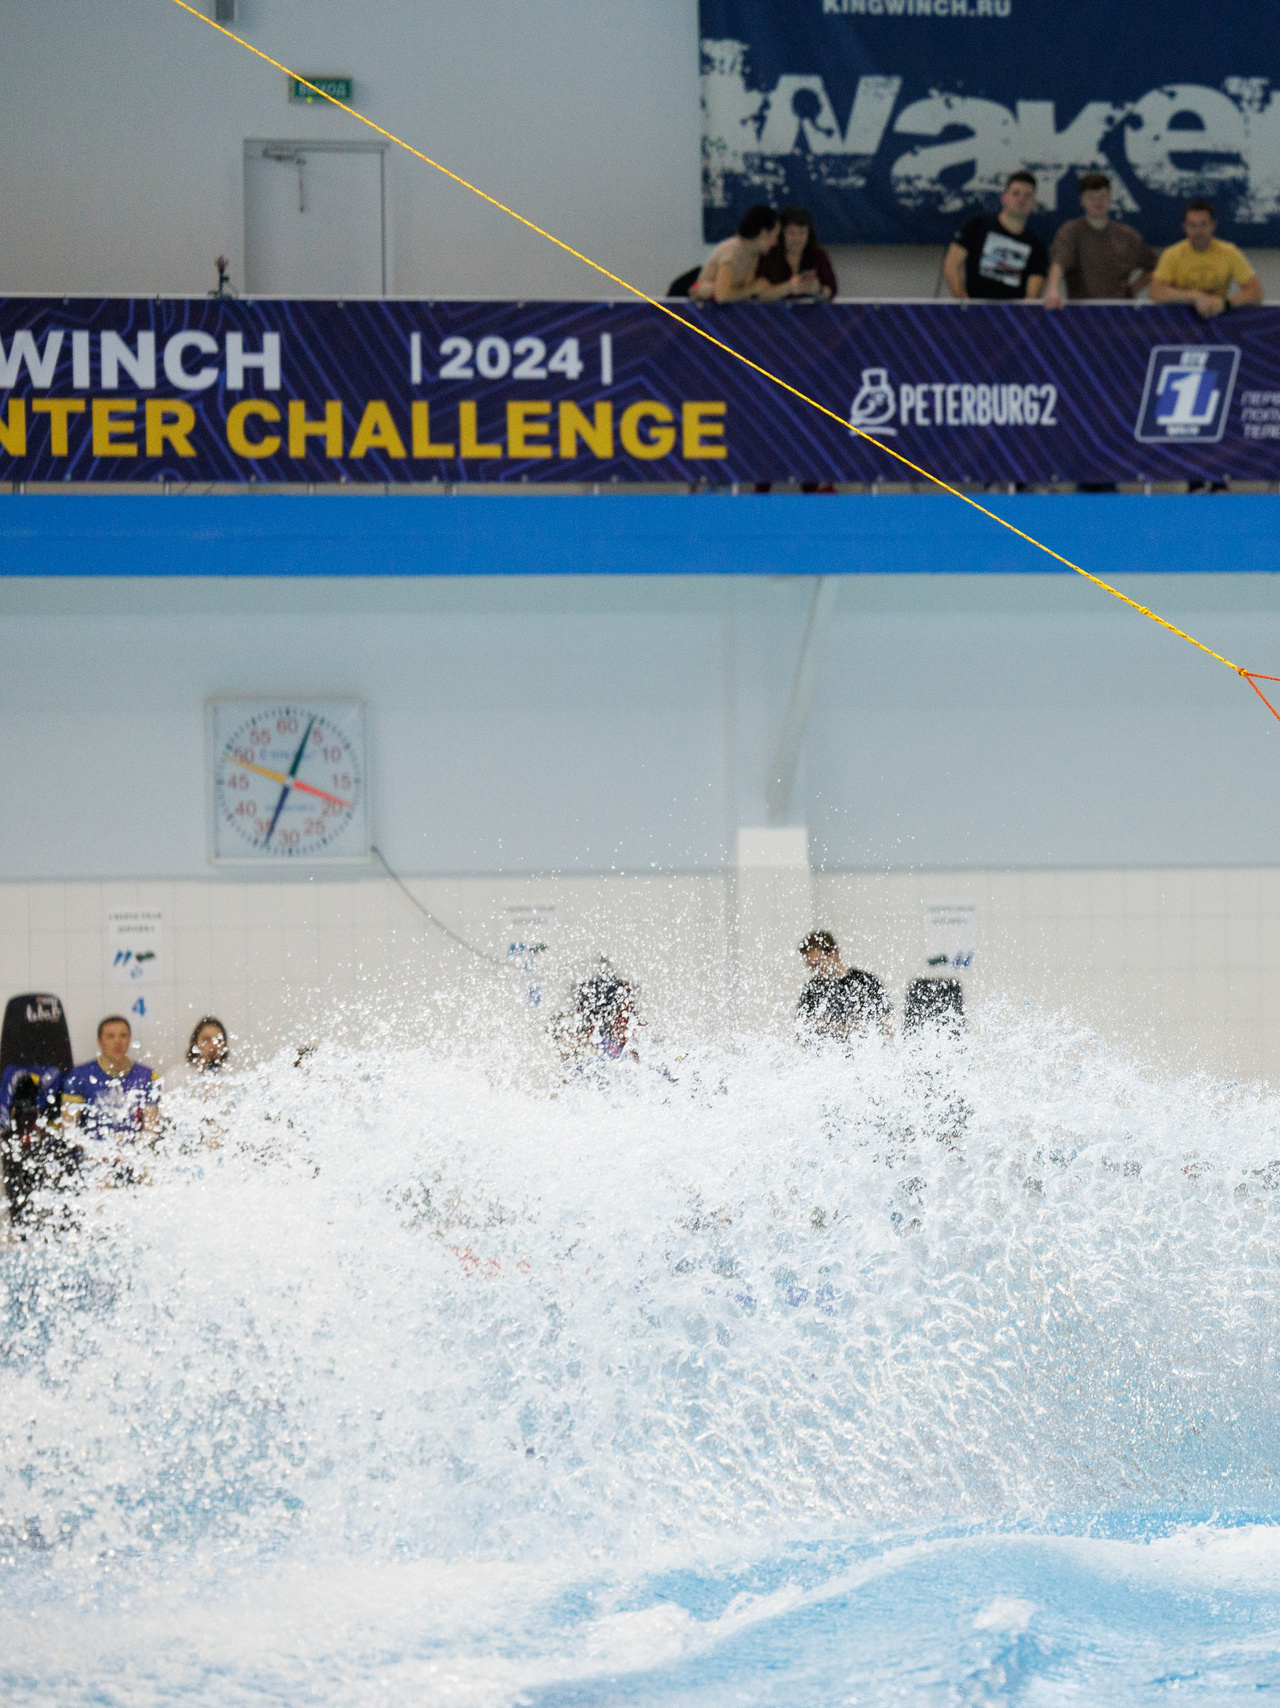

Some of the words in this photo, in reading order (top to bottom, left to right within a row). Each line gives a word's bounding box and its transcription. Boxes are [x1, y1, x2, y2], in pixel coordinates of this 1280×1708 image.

[0, 329, 281, 390] WINCH
[900, 383, 1058, 427] PETERBURG2
[226, 400, 728, 460] CHALLENGE
[276, 718, 299, 735] 60
[251, 728, 271, 746] 55
[312, 728, 324, 745] 5
[322, 746, 342, 763] 10
[227, 774, 249, 791] 45
[333, 773, 351, 790] 15
[235, 801, 257, 817] 40
[304, 818, 326, 835] 25
[279, 829, 300, 846] 30
[132, 997, 146, 1016] 4
